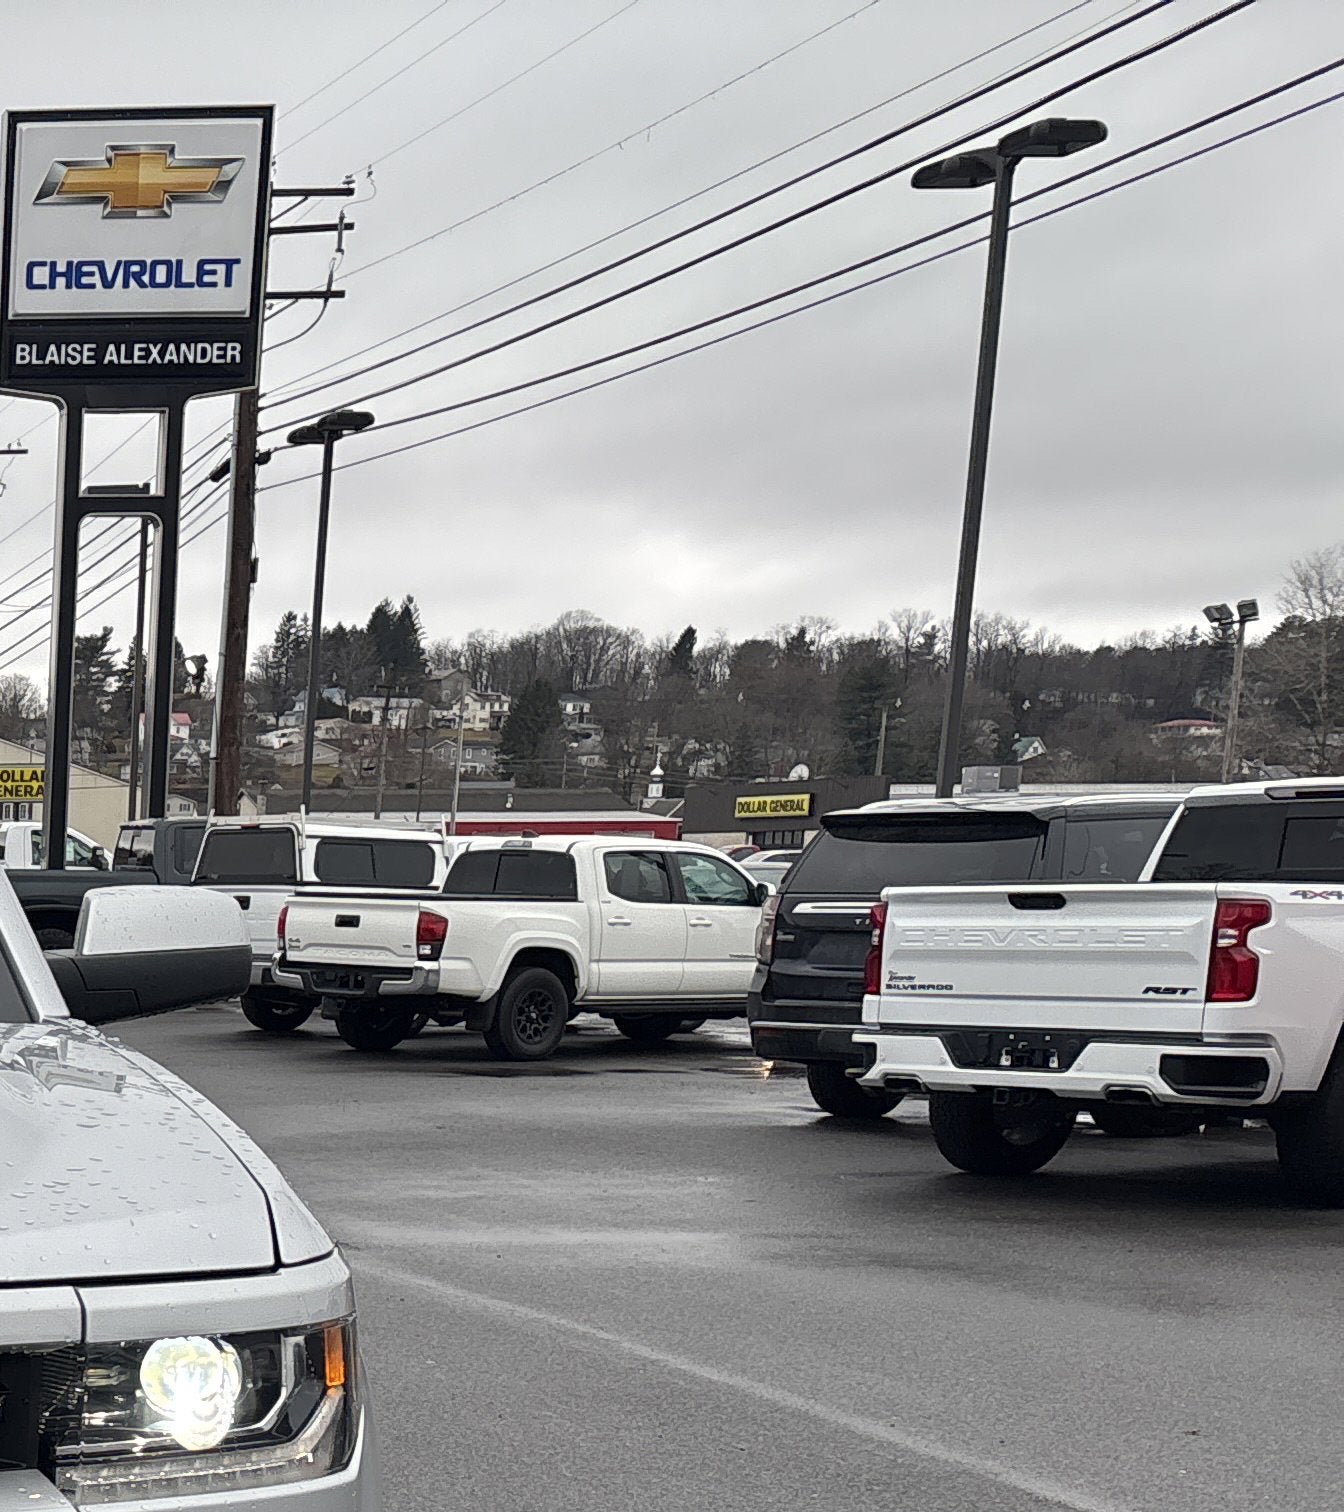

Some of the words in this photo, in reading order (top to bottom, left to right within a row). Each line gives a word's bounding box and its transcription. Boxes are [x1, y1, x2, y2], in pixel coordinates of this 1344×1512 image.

[25, 258, 242, 290] CHEVROLET
[15, 343, 97, 365] BLAISE
[102, 342, 242, 365] ALEXANDER
[737, 800, 768, 814] DOLLAR
[769, 798, 806, 813] GENERAL
[899, 928, 1185, 947] CHEVROLET
[1142, 986, 1198, 996] RST
